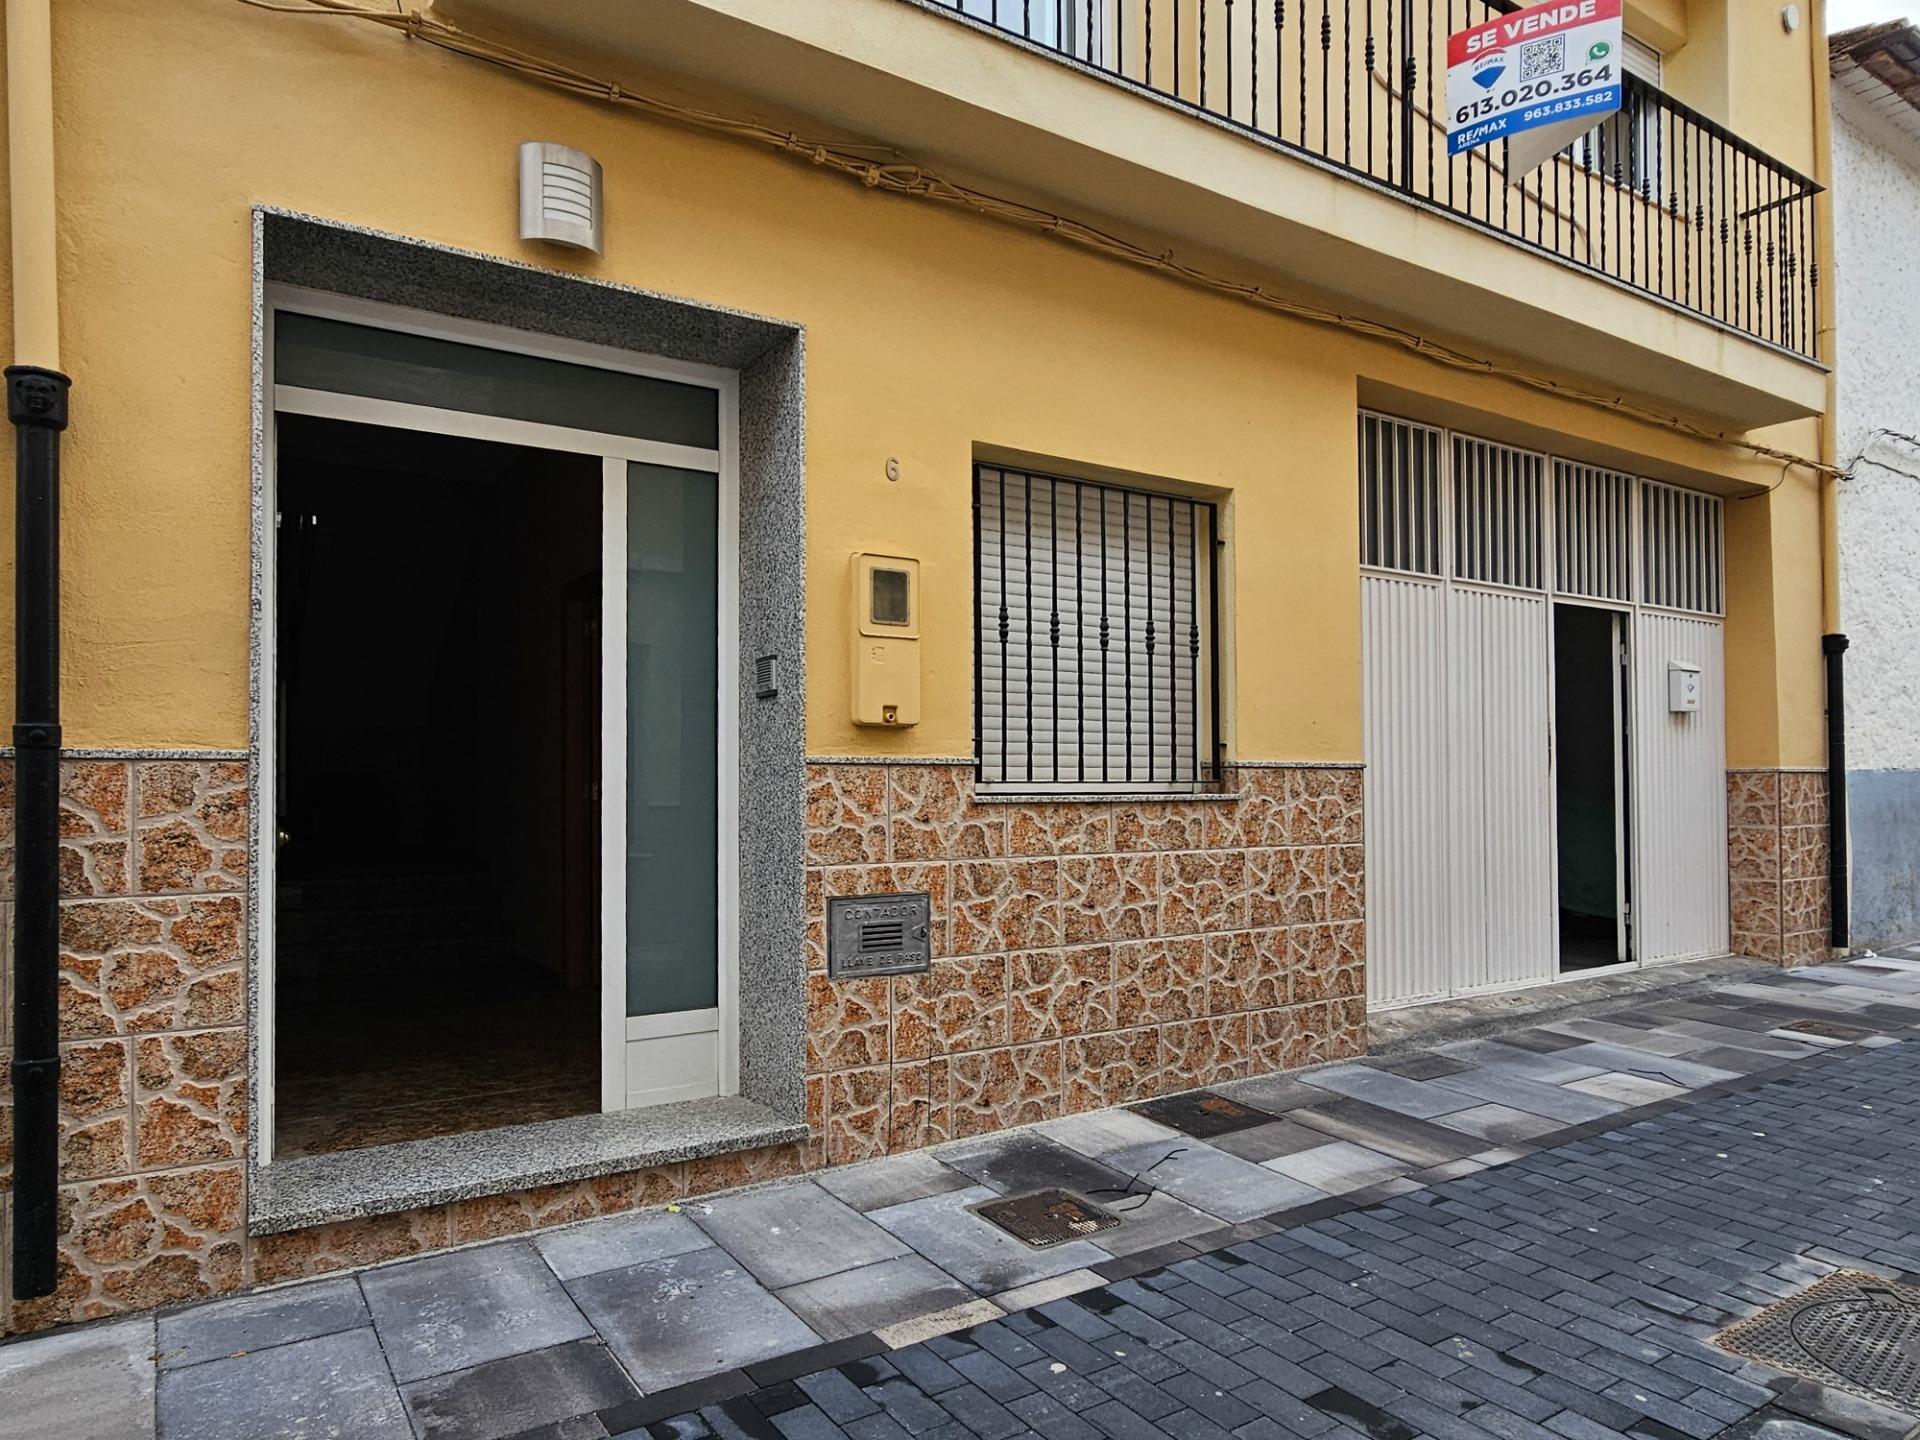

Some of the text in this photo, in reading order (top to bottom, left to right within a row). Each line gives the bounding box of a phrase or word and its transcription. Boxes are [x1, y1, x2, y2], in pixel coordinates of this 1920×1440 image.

[1466, 1, 1596, 53] SE VENDE
[1474, 56, 1504, 71] RE/MAX
[1456, 64, 1613, 124] 613.020.364
[1524, 91, 1613, 121] 963.833.582
[1457, 118, 1507, 144] RE/MAX
[1458, 137, 1480, 149] ARENA
[886, 456, 900, 481] 6
[844, 904, 918, 920] CONTADOR
[841, 951, 922, 968] LLAVE DE PASO
